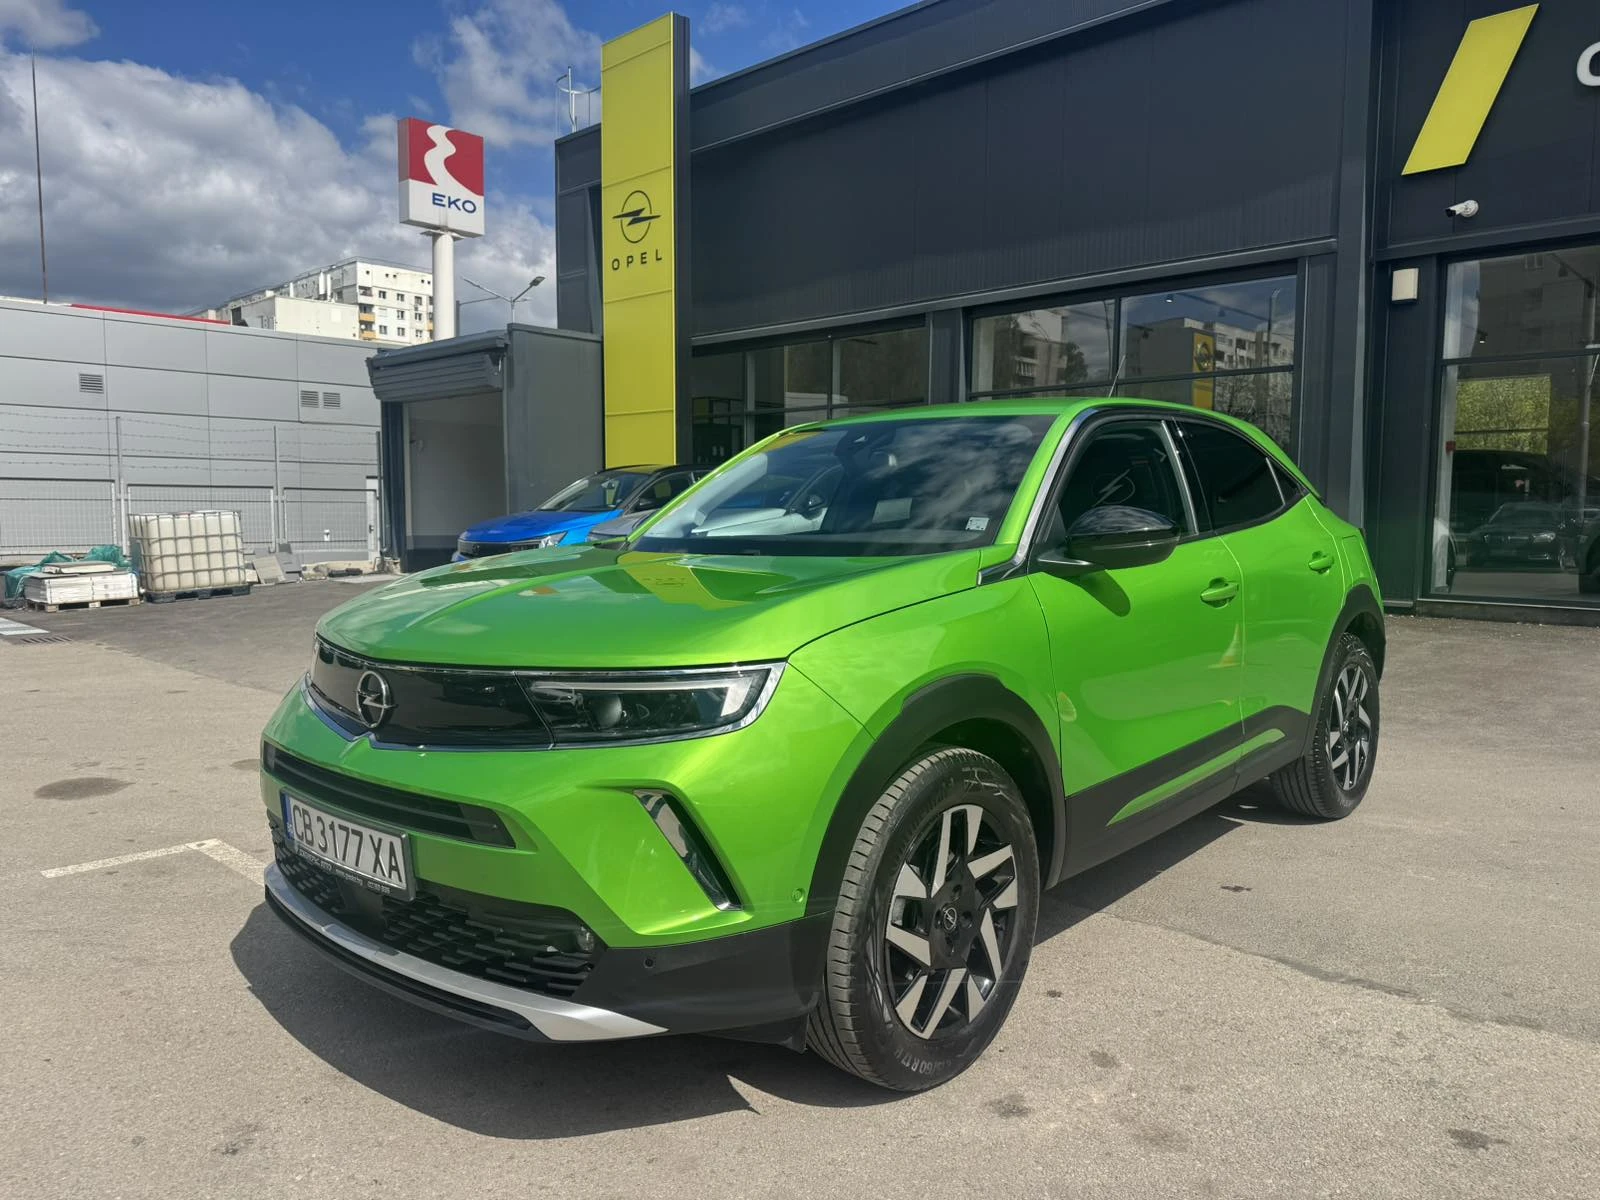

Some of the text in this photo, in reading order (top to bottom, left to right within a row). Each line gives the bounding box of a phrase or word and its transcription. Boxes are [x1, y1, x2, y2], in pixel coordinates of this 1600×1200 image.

[432, 192, 477, 214] EKO
[611, 248, 663, 271] OPEL
[292, 804, 315, 847] CB
[316, 815, 364, 868] 3177
[369, 834, 403, 883] XA
